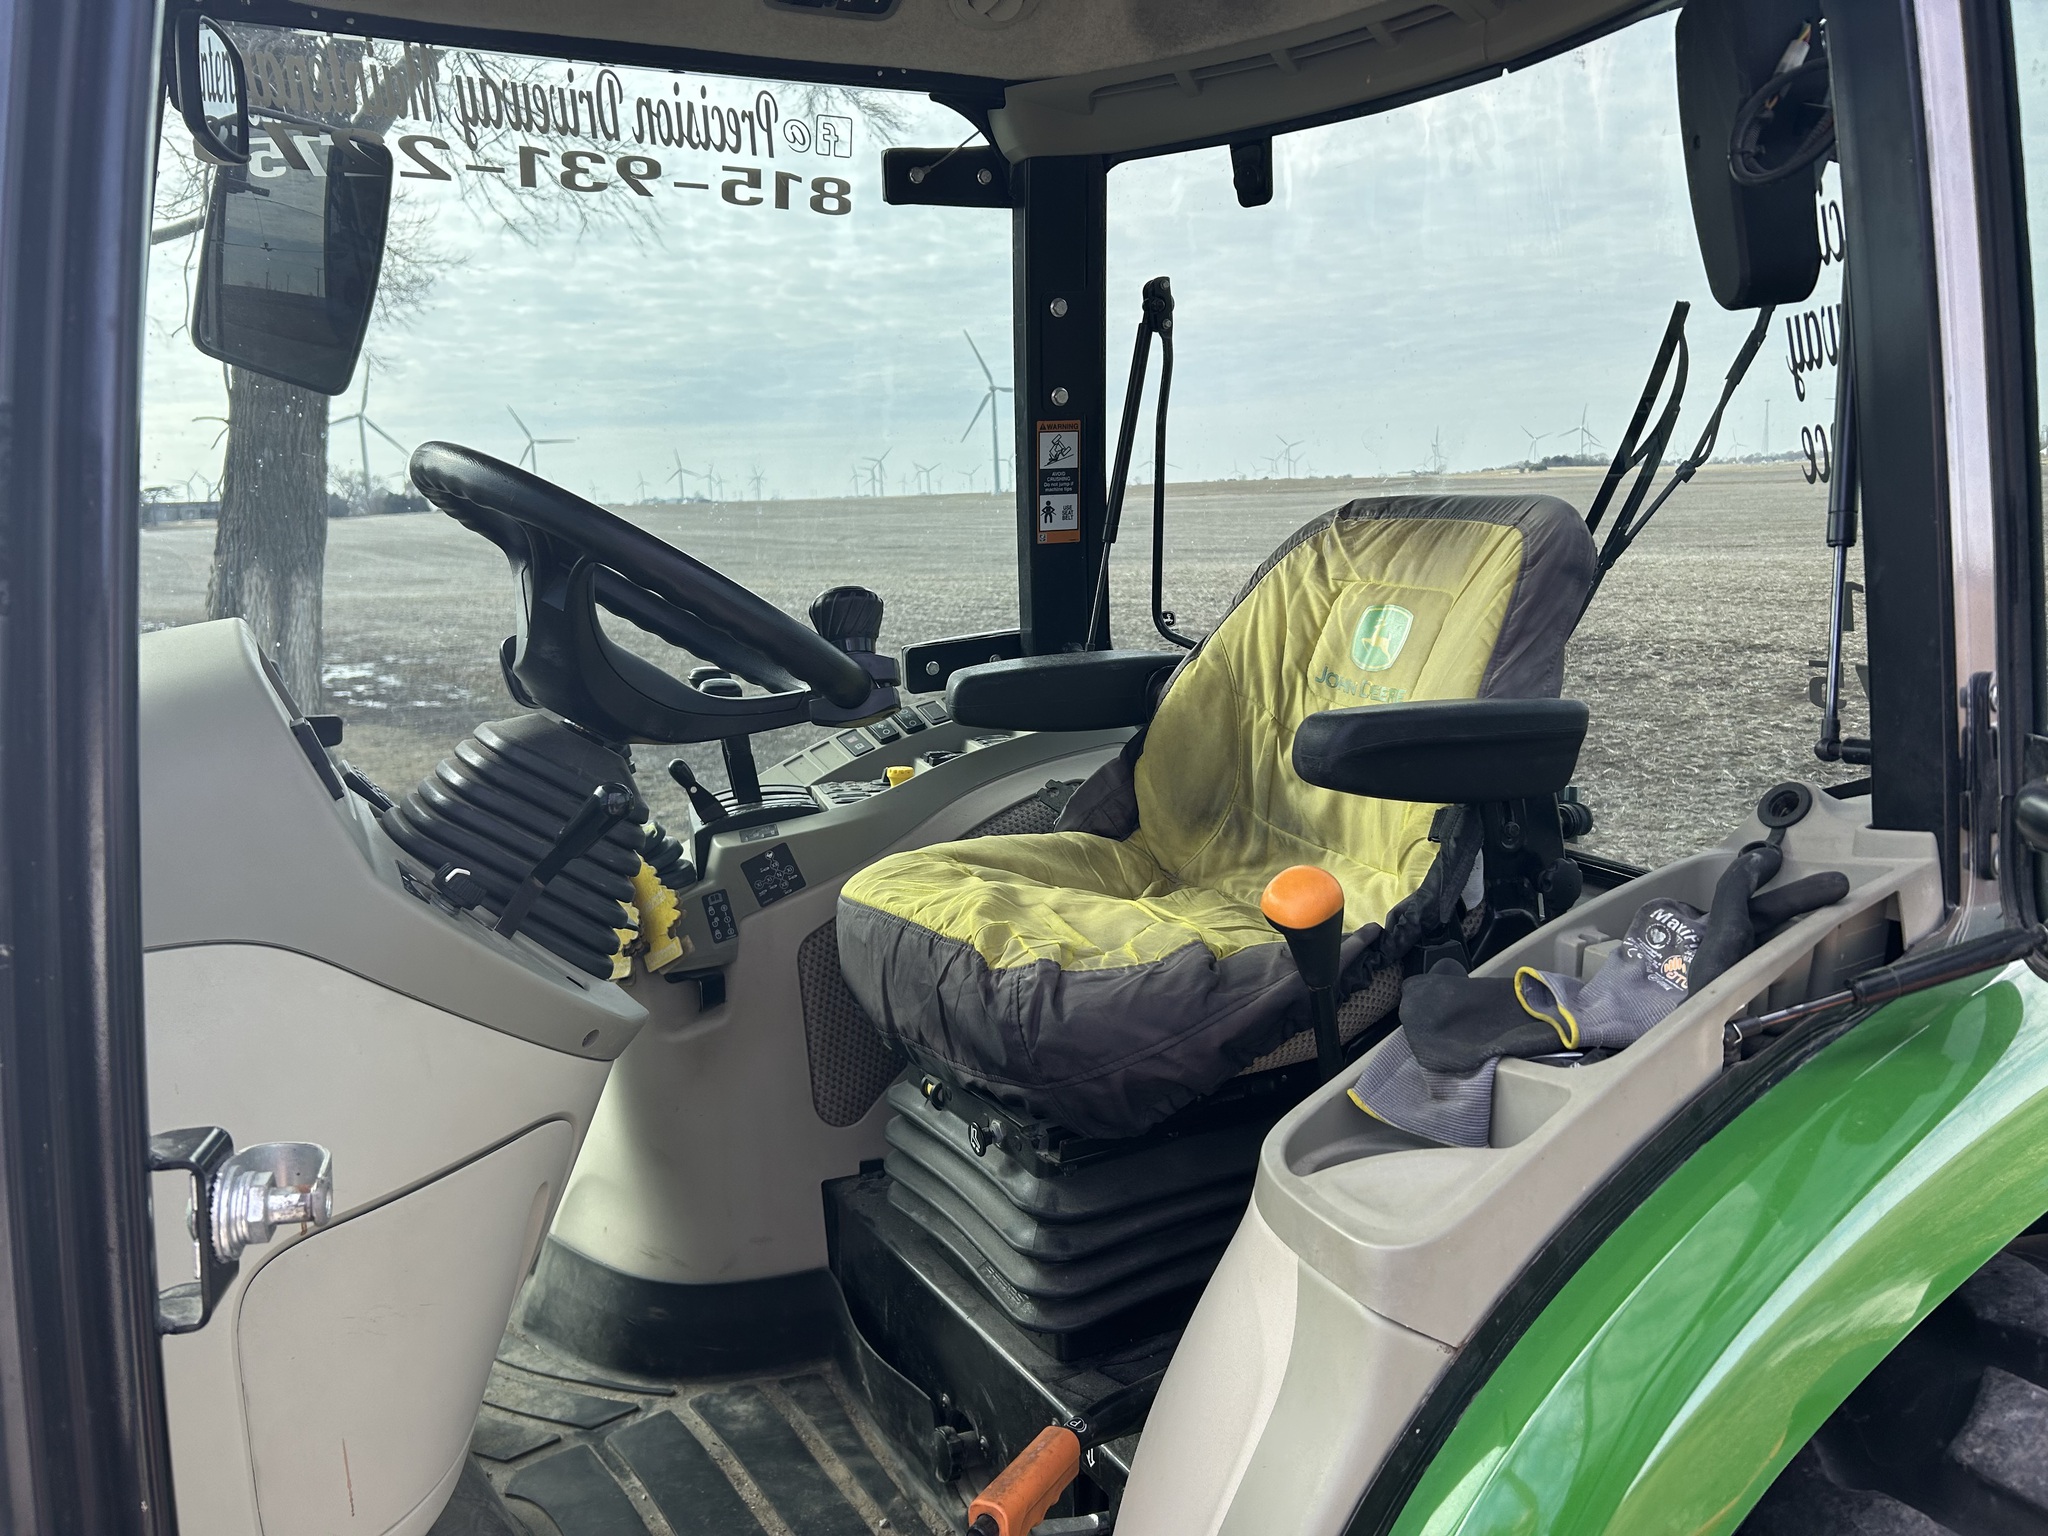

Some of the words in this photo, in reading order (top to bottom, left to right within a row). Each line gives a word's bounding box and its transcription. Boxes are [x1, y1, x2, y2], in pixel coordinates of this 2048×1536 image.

[1046, 423, 1079, 431] WARNING
[1314, 665, 1358, 696] JOHN
[1359, 679, 1407, 704] DEERE
